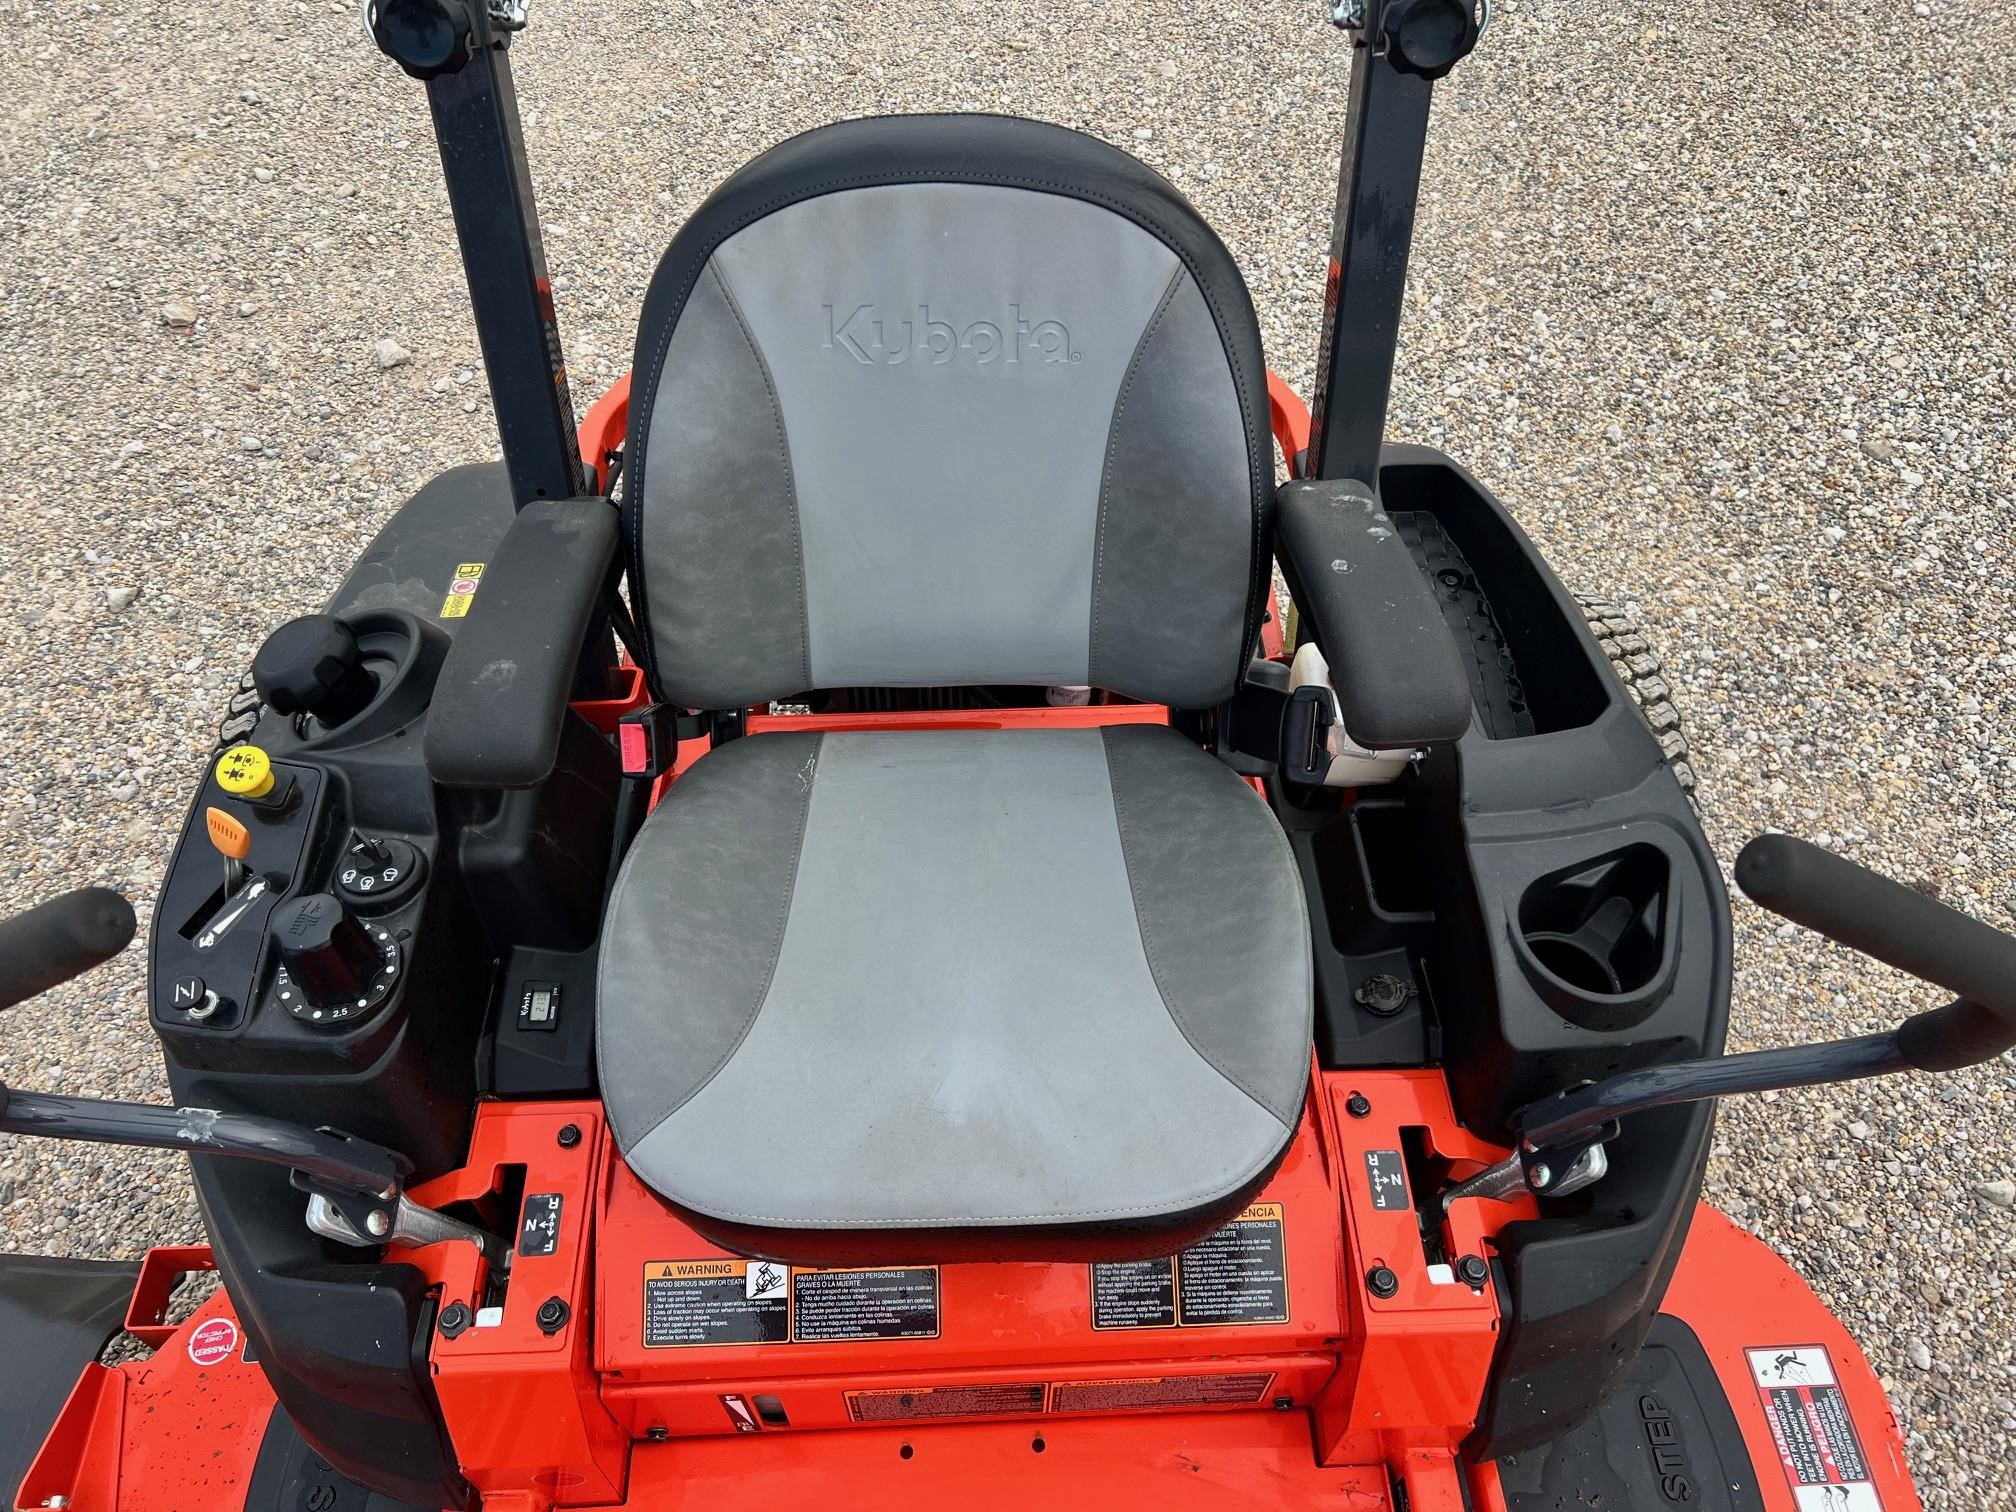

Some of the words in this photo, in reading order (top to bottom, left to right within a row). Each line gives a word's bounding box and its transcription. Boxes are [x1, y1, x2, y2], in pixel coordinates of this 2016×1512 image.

[821, 303, 1070, 364] Kubota
[386, 944, 396, 958] 3.5
[294, 1004, 302, 1012] 2
[332, 1008, 348, 1018] 2.5
[1368, 1154, 1378, 1166] R
[1390, 1174, 1402, 1185] N
[548, 1198, 559, 1209] R
[1376, 1194, 1386, 1206] F
[526, 1219, 537, 1231] N
[544, 1240, 554, 1252] F
[676, 1264, 731, 1275] WARNING
[194, 1344, 230, 1357] PASSED
[1772, 1397, 1783, 1408] OR
[1780, 1390, 1794, 1411] WHEN
[1764, 1404, 1790, 1454] DANGER
[1777, 1410, 1792, 1435] HANDS
[1787, 1412, 1804, 1442] MOWER
[1804, 1402, 1830, 1453] PELIGRO
[1639, 1395, 1691, 1501] STEP
[1786, 1437, 1798, 1451] PUT
[1797, 1443, 1810, 1461] INTO
[1791, 1452, 1804, 1469] NOT
[1810, 1452, 1827, 1481] ENGINE
[1796, 1470, 1808, 1482] DO
[1804, 1462, 1817, 1481] FEET
